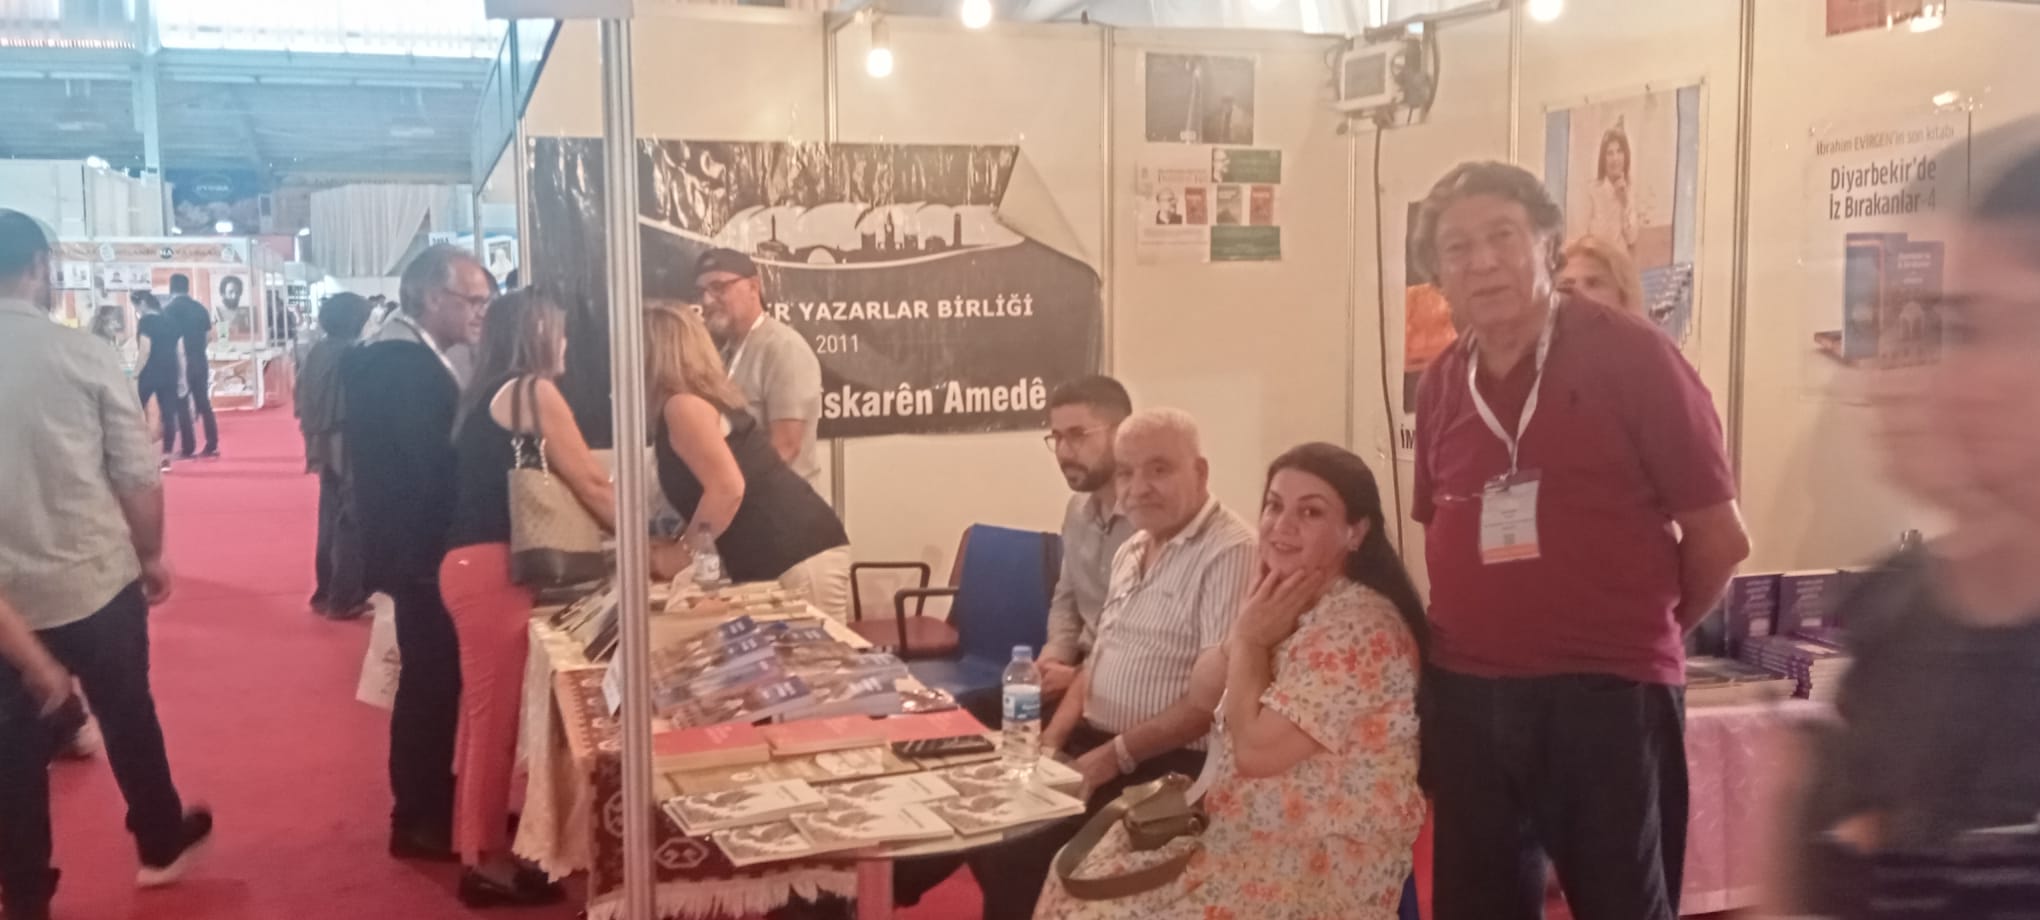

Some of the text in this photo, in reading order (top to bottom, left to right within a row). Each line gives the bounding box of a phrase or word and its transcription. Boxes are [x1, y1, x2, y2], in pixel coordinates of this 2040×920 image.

[1830, 155, 1937, 193] Diyarbekir'de
[798, 300, 929, 321] YAZARLAR
[937, 293, 1033, 319] BİRLİĞİ
[816, 335, 859, 353] 2011
[943, 377, 1047, 414] Amedê
